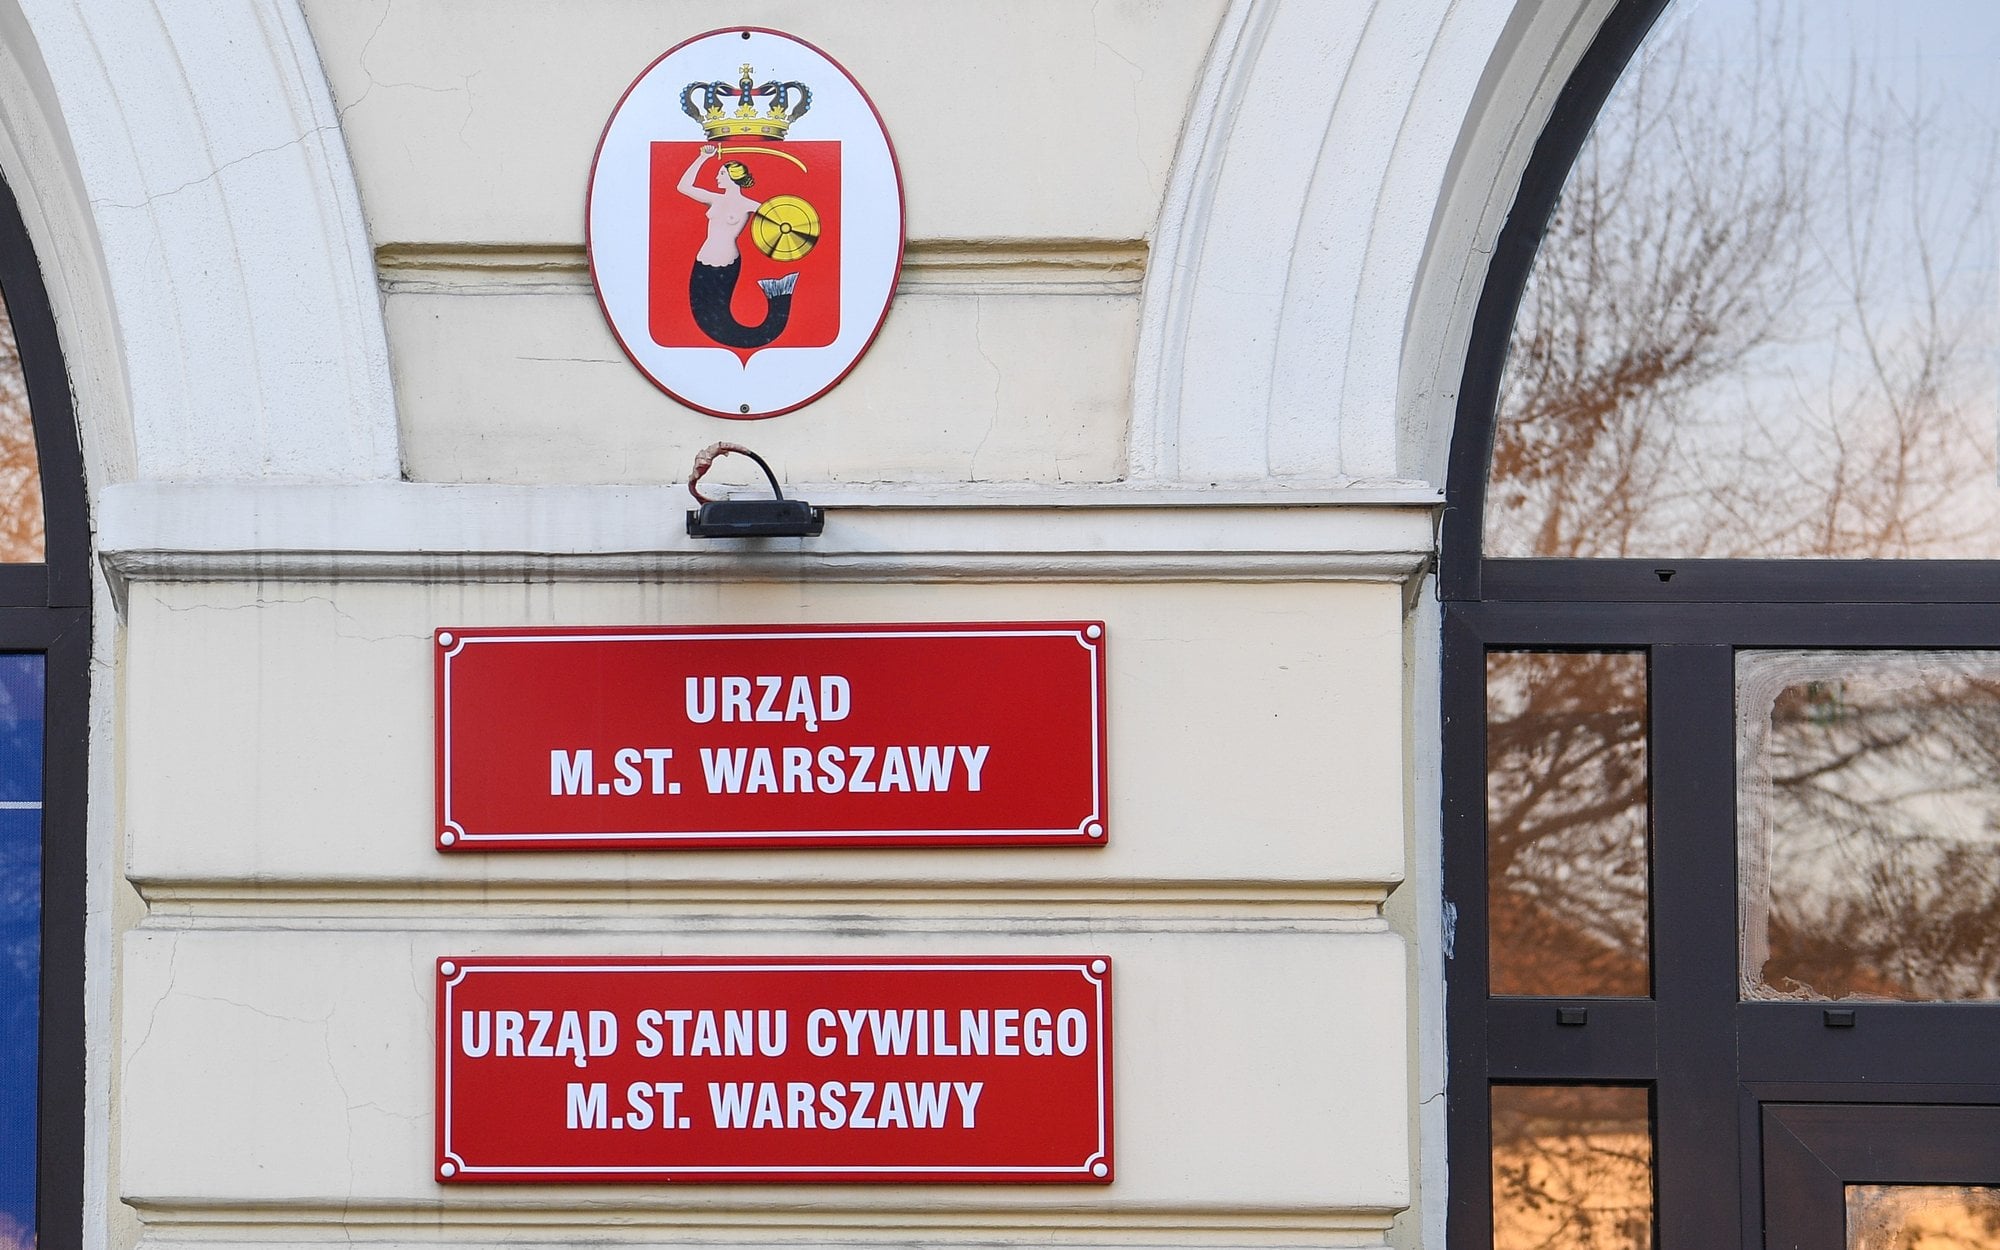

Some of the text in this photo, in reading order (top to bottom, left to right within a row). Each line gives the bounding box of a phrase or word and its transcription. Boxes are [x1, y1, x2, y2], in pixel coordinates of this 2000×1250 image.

[685, 675, 851, 733] URZĄD
[550, 745, 990, 796] M.ST. WARSZAWY
[461, 1008, 1087, 1068] URZĄD STANU CYWILNEGO
[566, 1081, 984, 1130] M.ST. WARSZAWY
